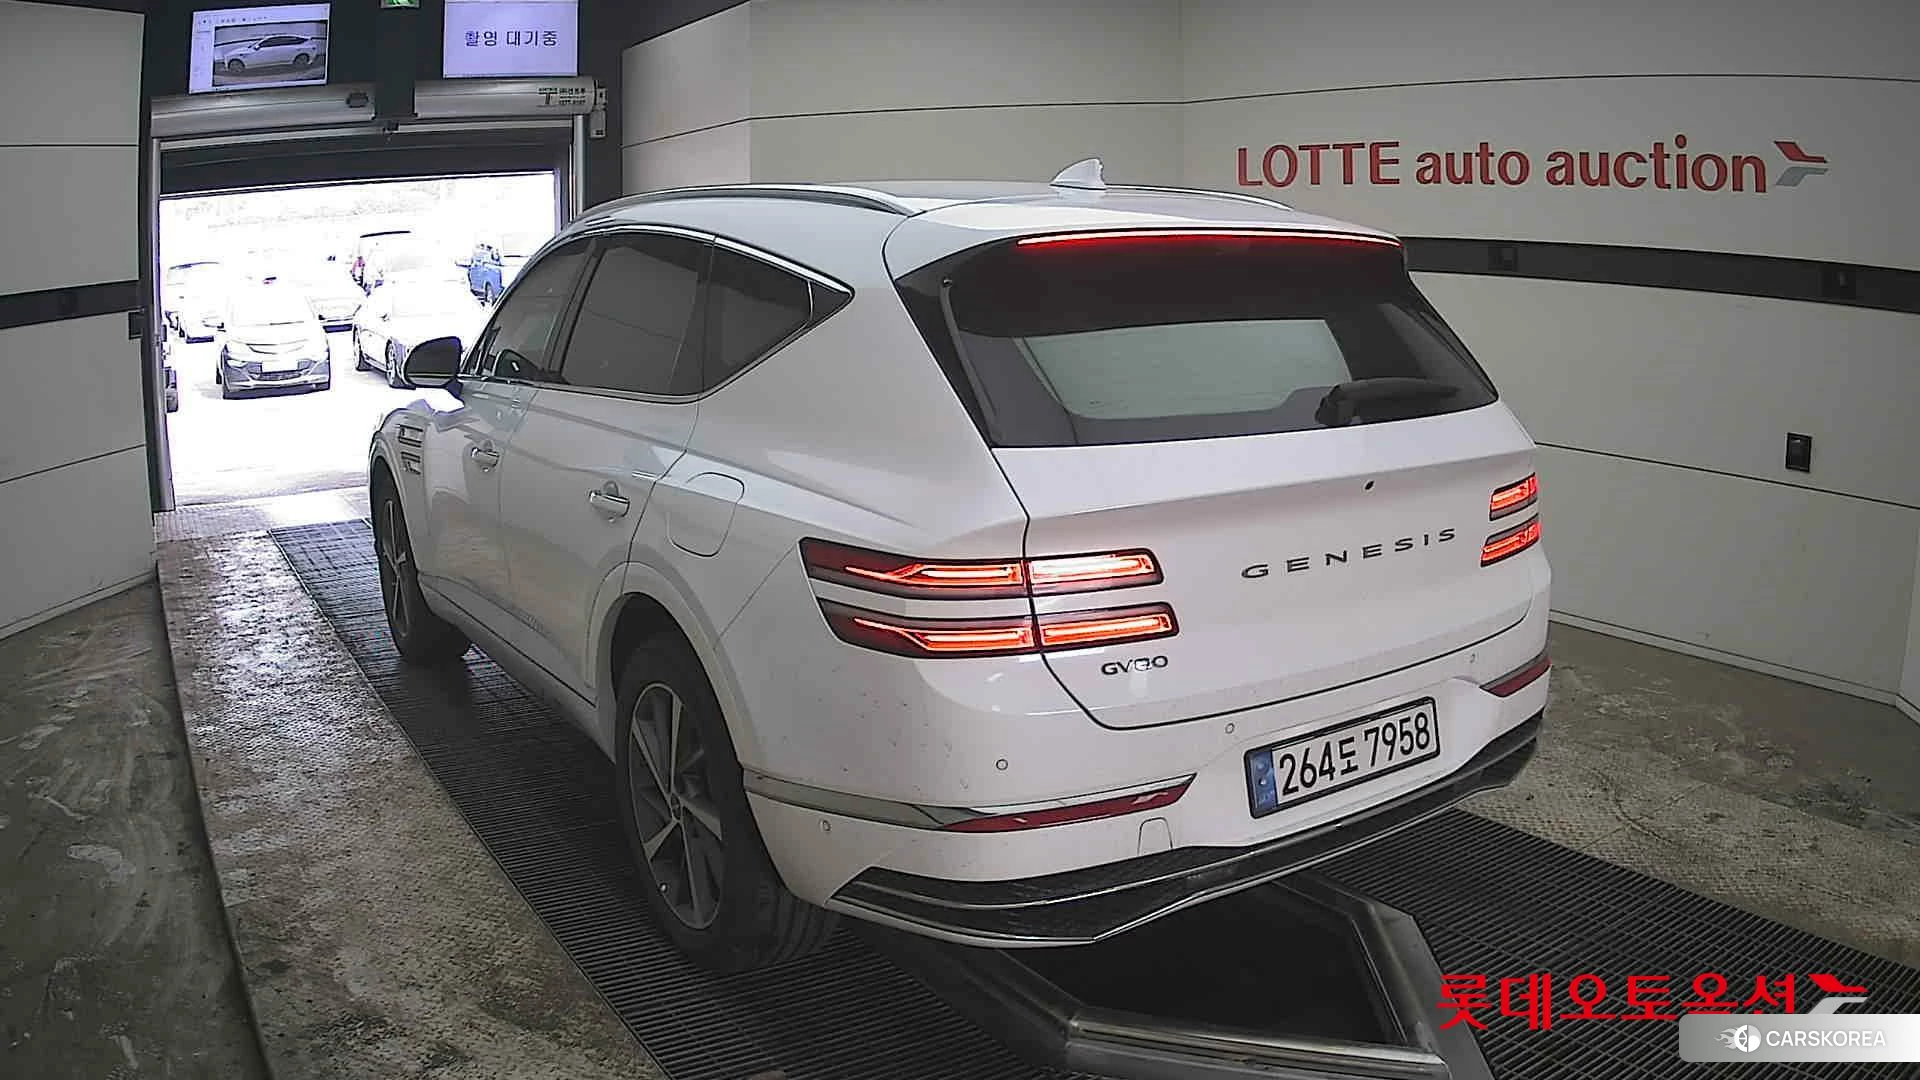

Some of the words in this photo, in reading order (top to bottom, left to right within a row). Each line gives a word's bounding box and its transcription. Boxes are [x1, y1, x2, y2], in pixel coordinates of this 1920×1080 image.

[506, 30, 558, 47] 대기중
[1237, 140, 1401, 188] LOTTE
[1415, 141, 1530, 186] auto
[1545, 133, 1768, 194] auction
[1241, 527, 1456, 579] GENESIS
[1279, 737, 1359, 796] 264도
[1363, 711, 1431, 767] 7958
